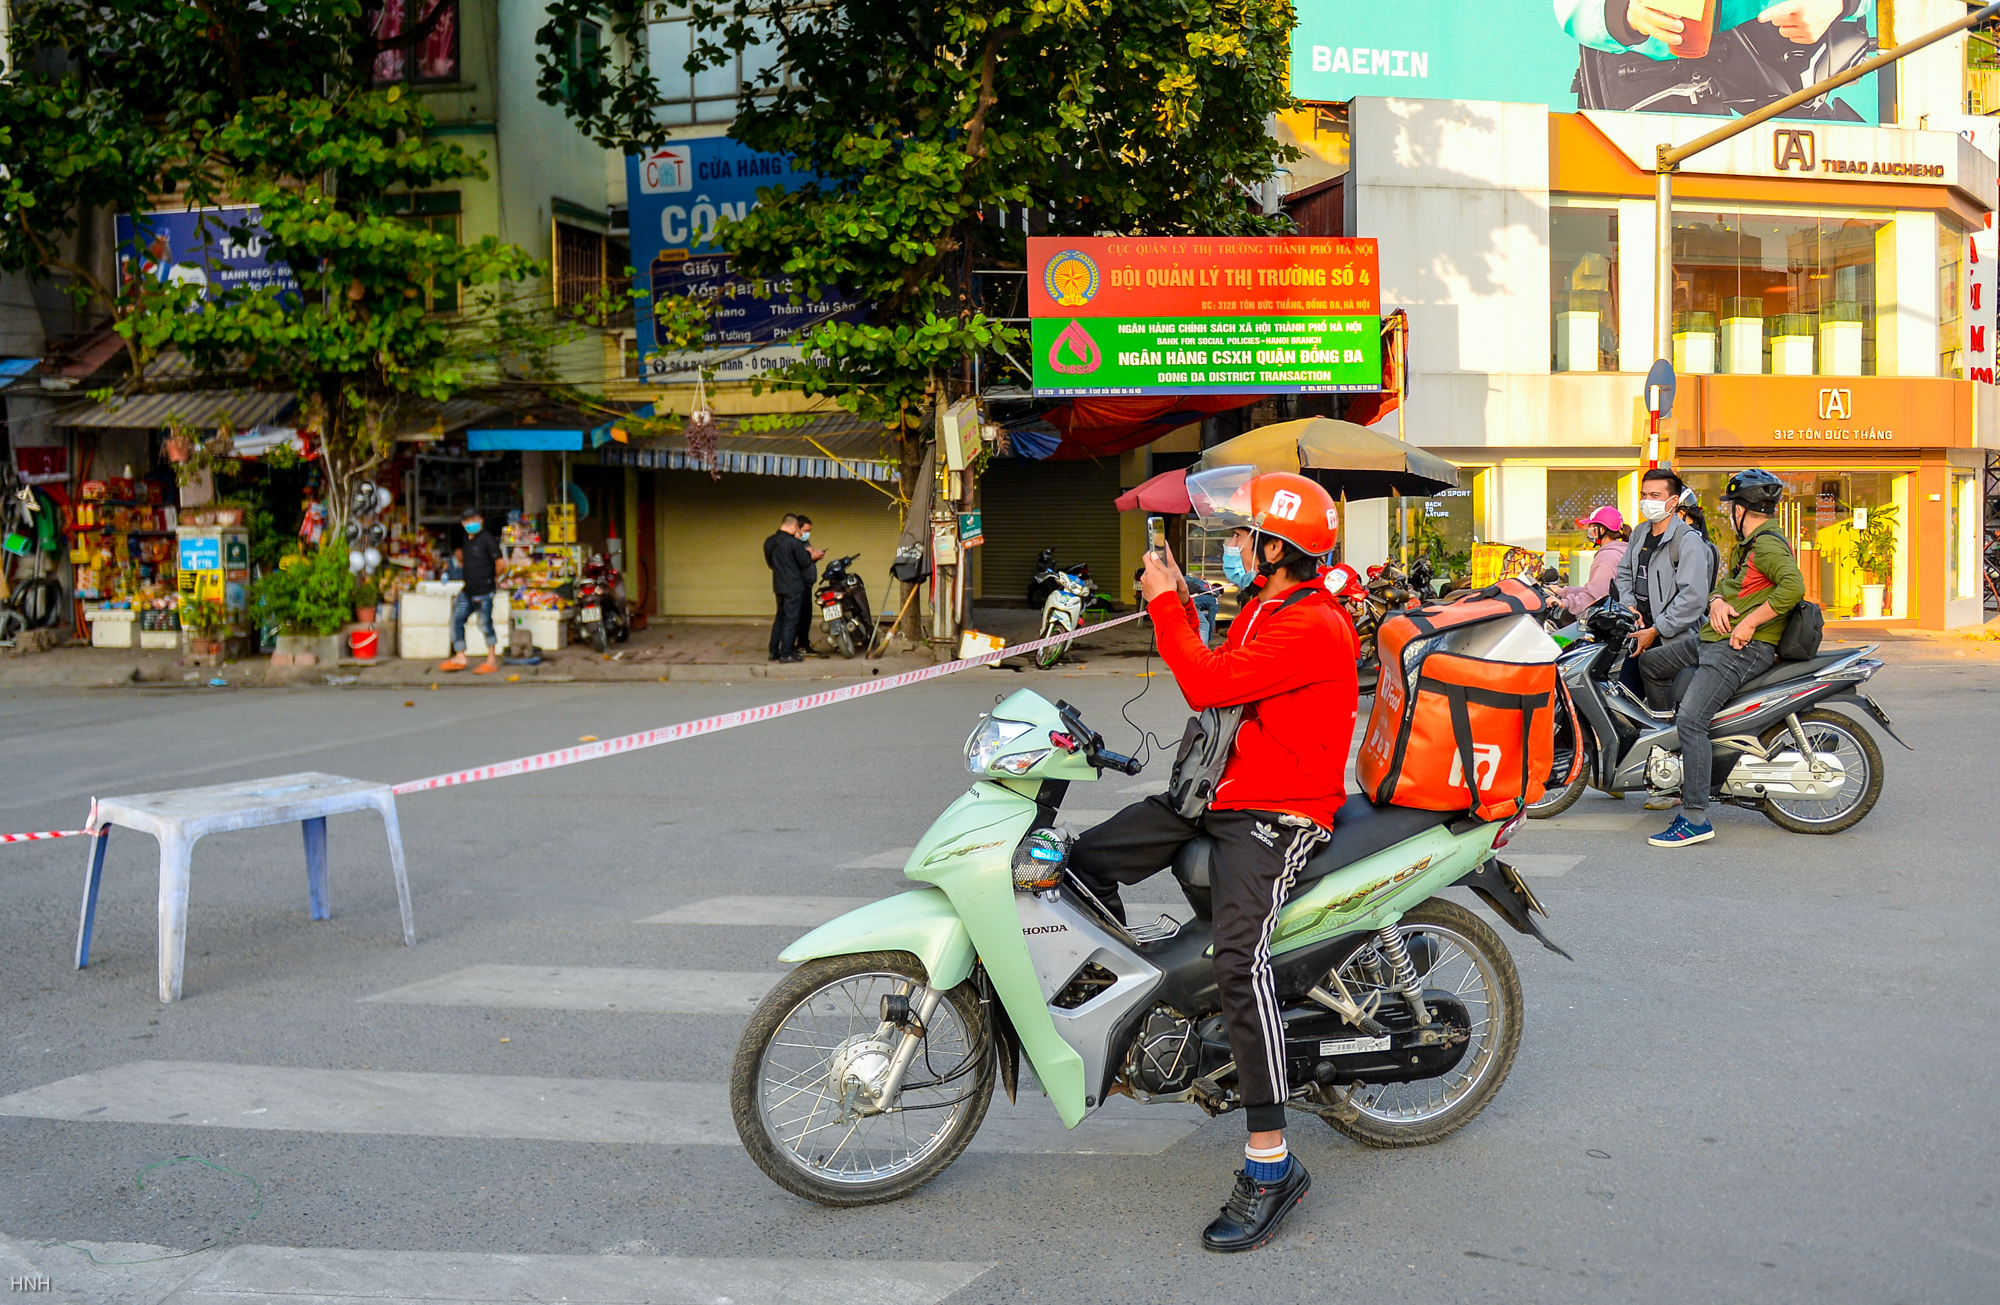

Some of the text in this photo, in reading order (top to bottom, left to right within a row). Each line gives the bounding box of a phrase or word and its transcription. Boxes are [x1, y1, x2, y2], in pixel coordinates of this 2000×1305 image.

[1312, 45, 1428, 78] BAEMIN
[699, 155, 732, 180] CỬA
[737, 154, 781, 177] HÀNG
[1821, 159, 1944, 178] TIBAO AUCHEHO
[1108, 241, 1373, 256] CỤC QUẢN LÝ THỊ TRƯỜNG THÀNH PHỐ HÀ NỘI
[1110, 262, 1370, 290] ĐỘI QUẢN LÝ THỊ TRƯỜNG SỐ 4
[1218, 301, 1236, 310] 312B
[1239, 299, 1255, 310] TÔN
[1258, 299, 1273, 310] ĐỨC
[1276, 298, 1304, 311] THẮNG,
[1306, 298, 1327, 310] ĐỐNG
[1344, 299, 1354, 310] HÀ
[1357, 299, 1370, 311] NỘI
[1118, 319, 1362, 334] NGÂN HÀNG CHÍNH SÁCH XÃ HỘI THÀNH PHỐ HÀ NỘI
[1157, 337, 1178, 345] BANK
[1181, 337, 1196, 345] FOR
[1197, 337, 1224, 345] SOCIAL
[1291, 336, 1321, 344] BRANCH
[1118, 345, 1363, 367] NGÂN HÀNG CSXH QUẬN ĐỐNG ĐA
[1158, 371, 1331, 383] DONG DA DISTRICT TRANSACTION
[1773, 425, 1893, 441] 312 TÔN ĐỨC THẮNG
[1250, 830, 1274, 848] adidas
[1022, 923, 1069, 936] HONDA
